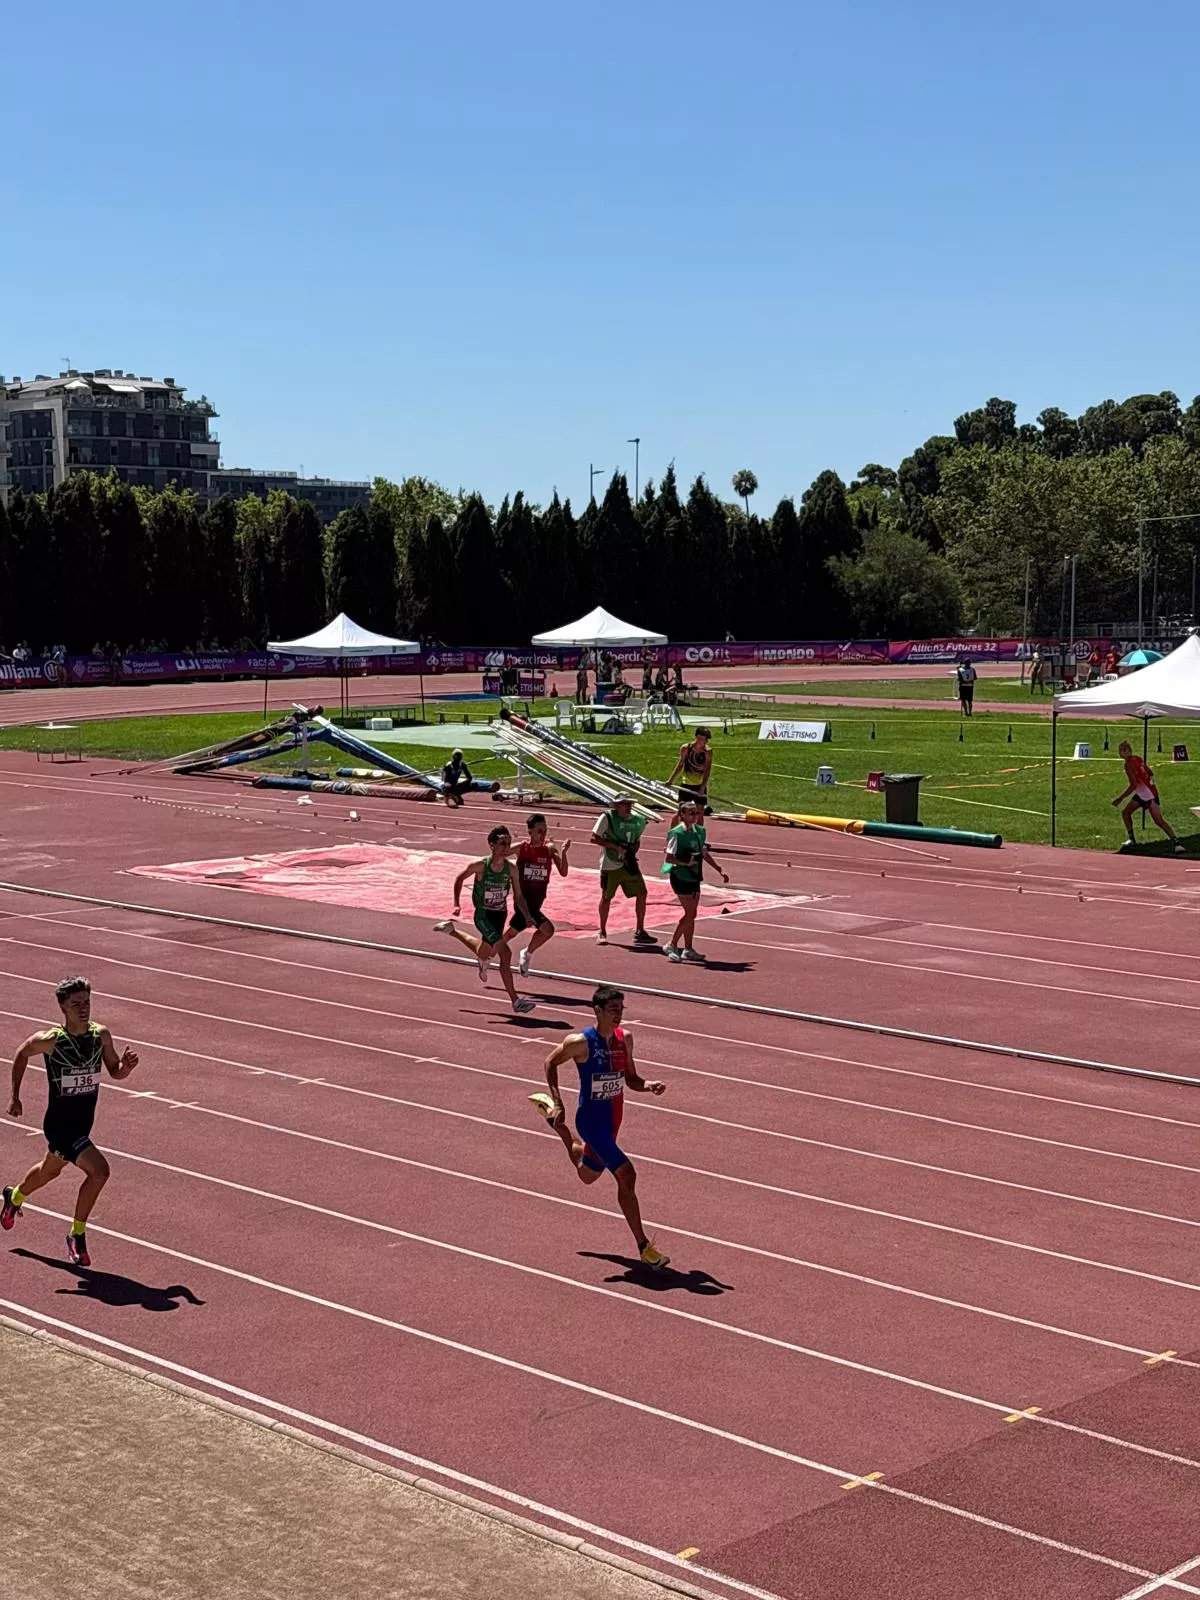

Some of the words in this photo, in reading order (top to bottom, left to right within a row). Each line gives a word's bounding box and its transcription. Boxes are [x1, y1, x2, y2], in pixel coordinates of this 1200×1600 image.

[911, 644, 944, 652] Allianz
[946, 643, 981, 651] Futures
[984, 643, 997, 651] 32
[763, 648, 815, 660] MONDO
[1081, 749, 1089, 757] 12
[820, 774, 832, 784] 12
[73, 1075, 93, 1087] 136
[602, 1081, 620, 1091] 605
